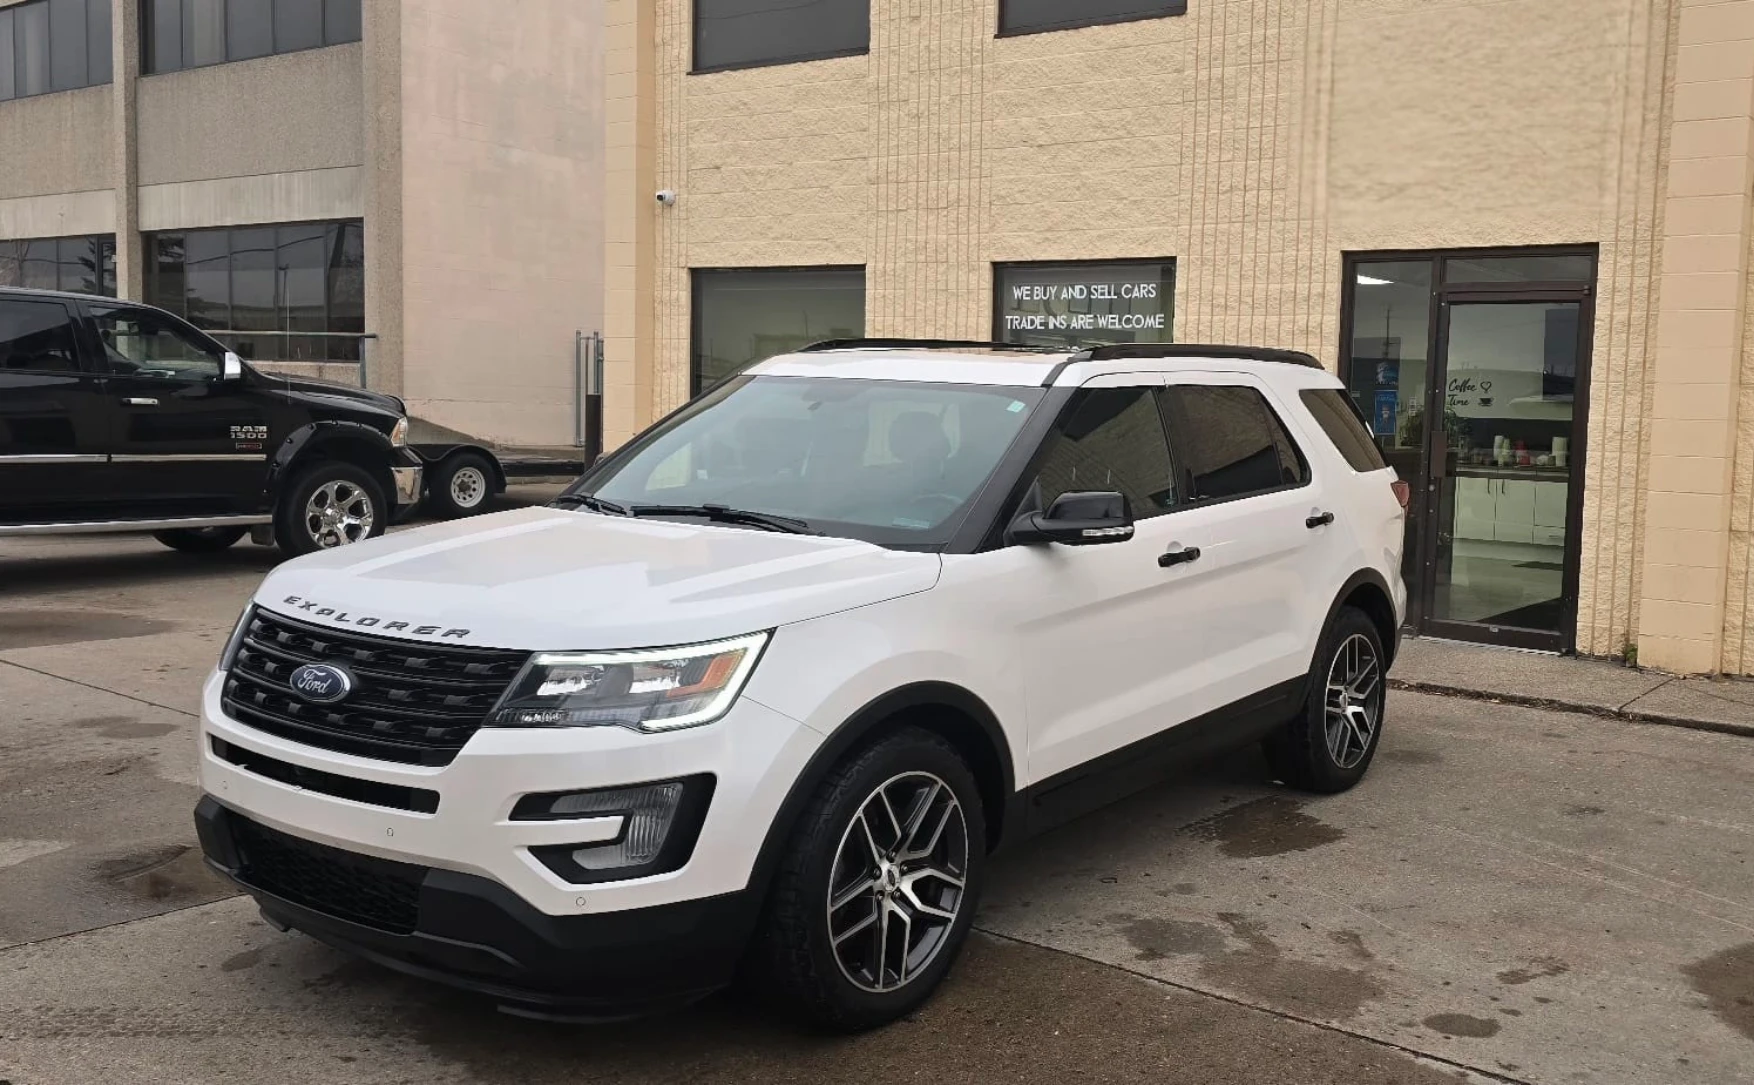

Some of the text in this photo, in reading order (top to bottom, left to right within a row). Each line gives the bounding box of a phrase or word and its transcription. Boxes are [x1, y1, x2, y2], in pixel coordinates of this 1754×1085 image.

[1013, 284, 1157, 300] WE BUY AND SELL CARS
[1005, 314, 1165, 330] TRADE INS ARE WELCOME
[1448, 378, 1477, 393] Coffee
[1447, 394, 1470, 407] Time
[230, 431, 268, 439] 1500
[283, 595, 471, 639] EXPLORER
[297, 668, 332, 694] Ford
